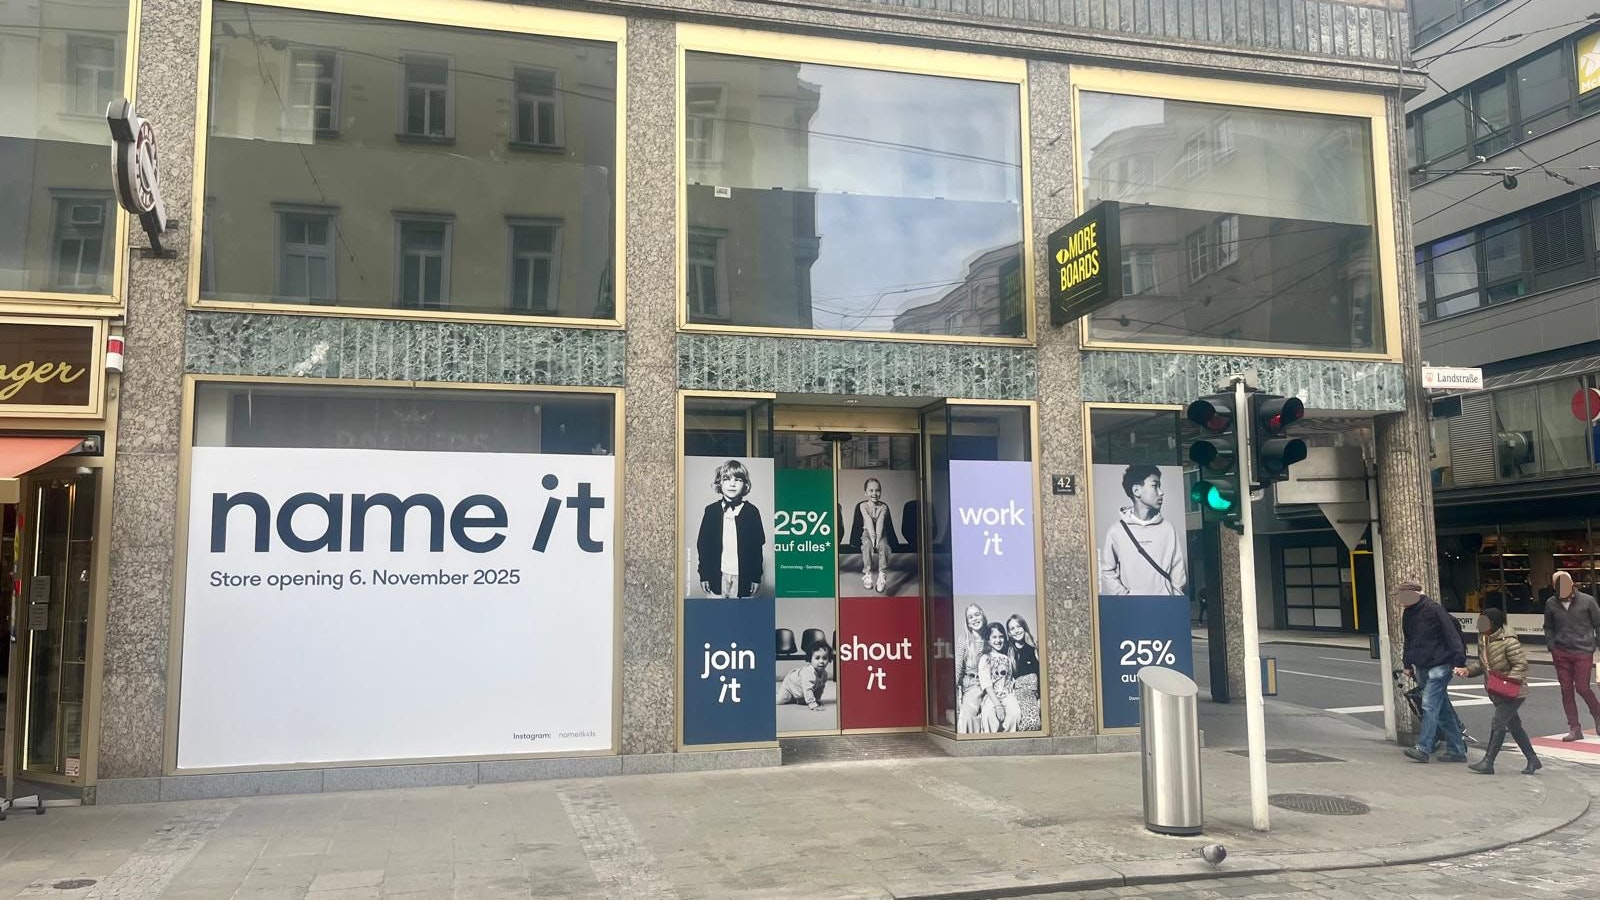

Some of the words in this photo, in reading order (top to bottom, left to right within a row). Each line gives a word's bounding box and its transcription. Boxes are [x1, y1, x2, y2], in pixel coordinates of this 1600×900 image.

[1068, 222, 1097, 260] MORE
[1061, 249, 1099, 291] BOARDS
[1437, 372, 1479, 384] Landstraße
[1057, 476, 1071, 488] 42
[210, 491, 509, 554] name
[532, 473, 606, 554] it
[774, 510, 831, 536] 25%
[958, 499, 1025, 526] work
[774, 540, 795, 552] auf
[983, 530, 1003, 556] it
[210, 570, 262, 588] Store
[266, 570, 344, 591] opening
[349, 570, 367, 586] 6.
[372, 569, 469, 587] November
[473, 569, 521, 586] 2025
[701, 642, 756, 679] join
[840, 635, 912, 661] shout
[1120, 640, 1176, 666] 25%
[718, 675, 741, 703] it
[866, 665, 887, 690] it
[513, 732, 552, 741] Instagram:
